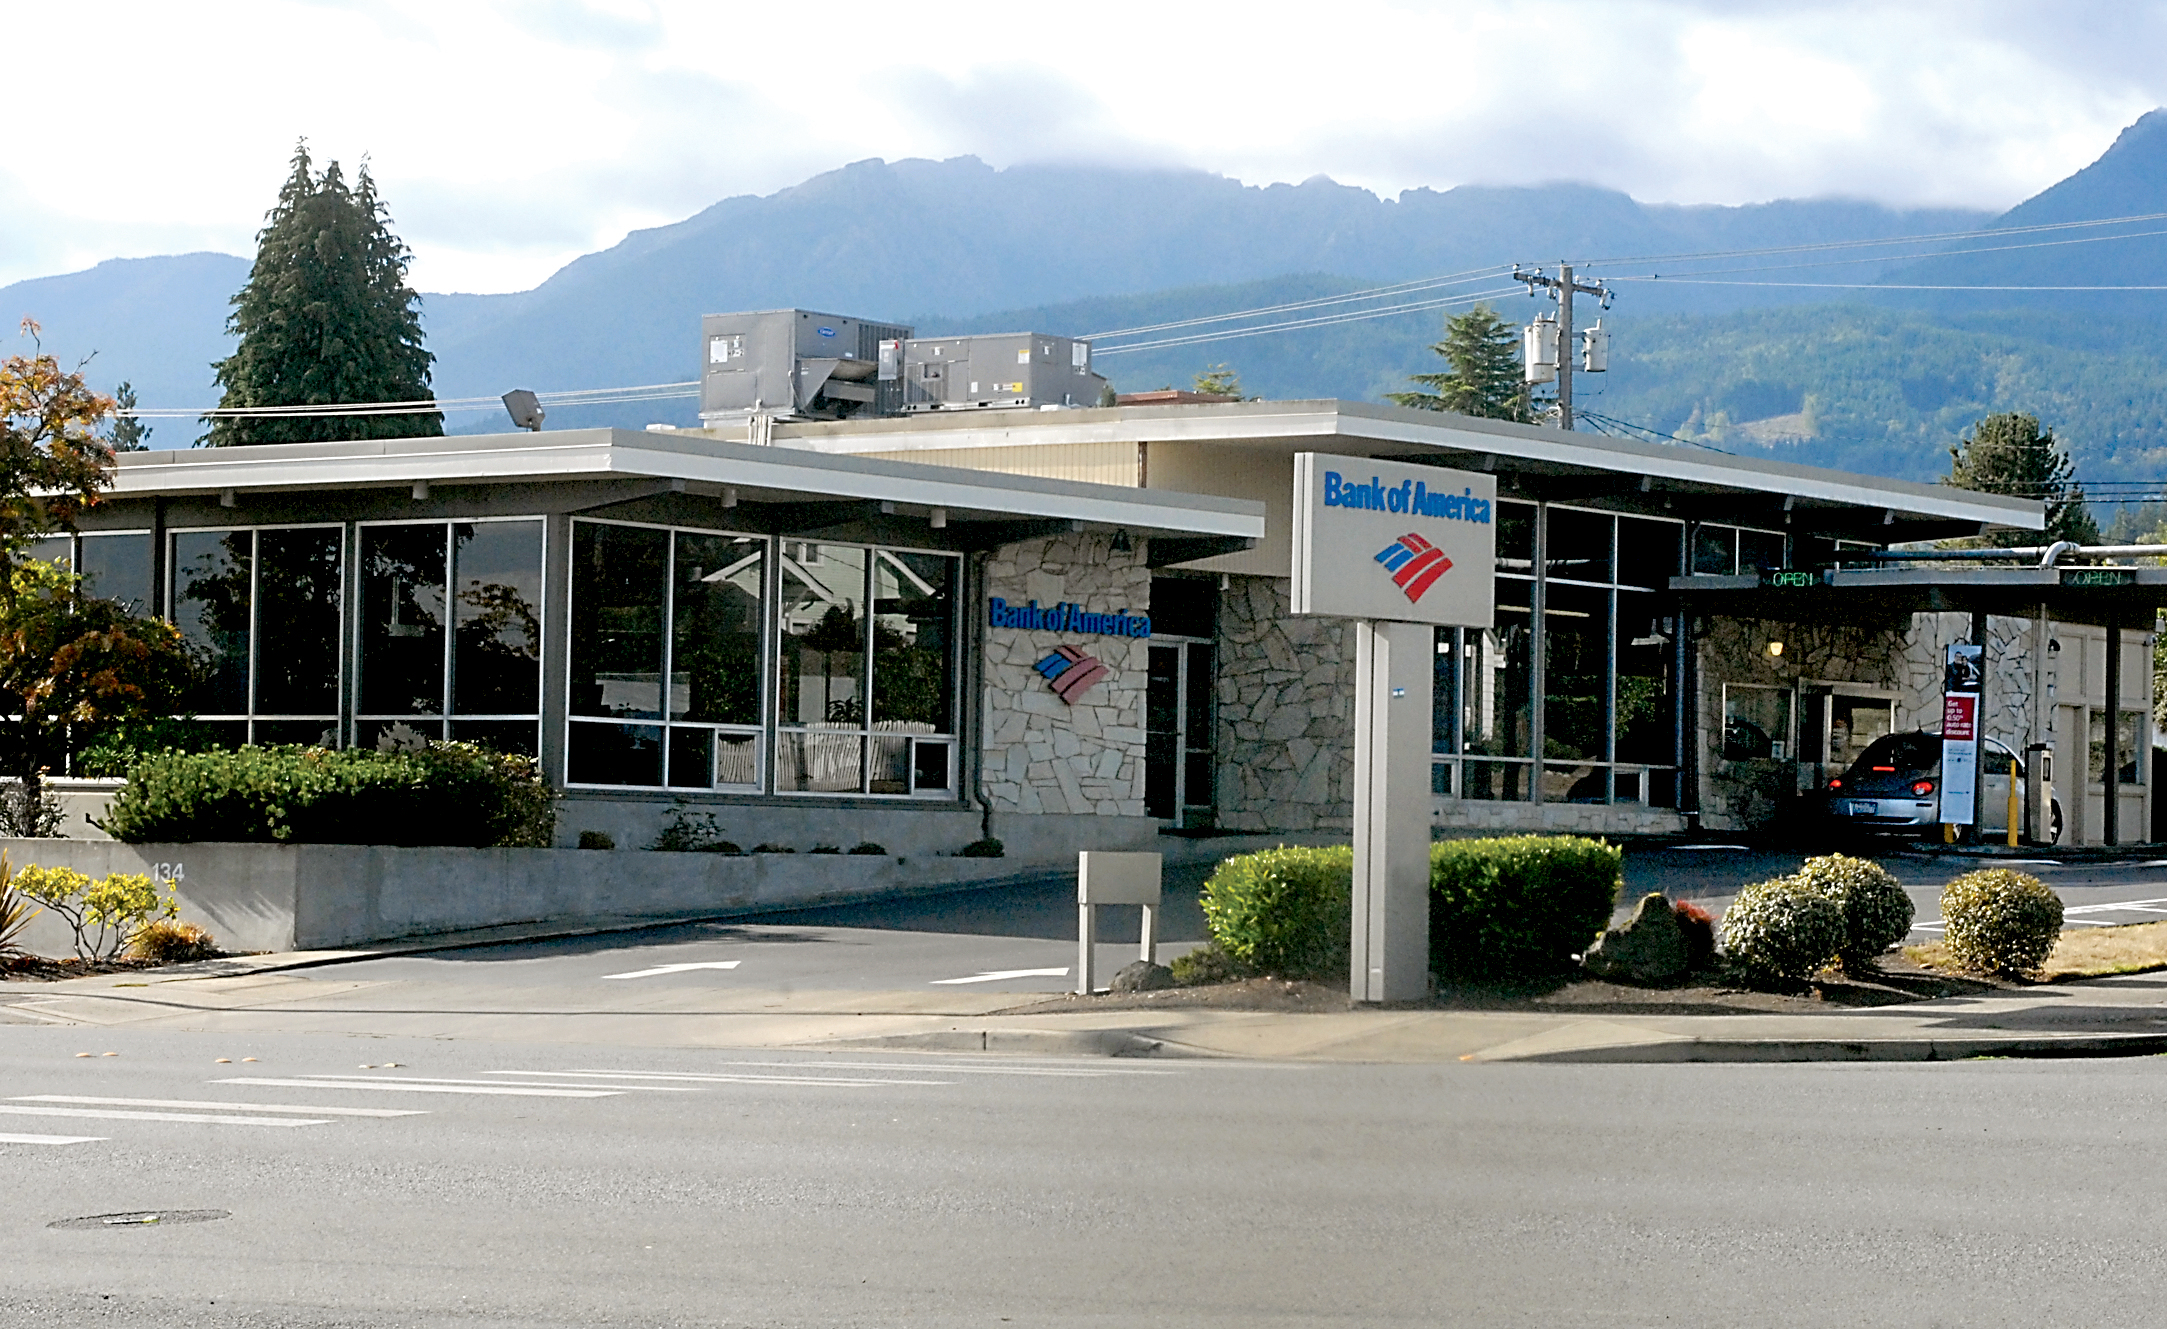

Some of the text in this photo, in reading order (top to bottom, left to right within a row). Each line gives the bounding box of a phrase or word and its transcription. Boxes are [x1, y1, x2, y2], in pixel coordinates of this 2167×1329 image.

[1324, 471, 1491, 524] Bank of America
[1773, 572, 1813, 587] OPEN
[2074, 571, 2121, 585] OPEN
[989, 597, 1151, 638] Bank of America
[152, 862, 185, 882] 134
